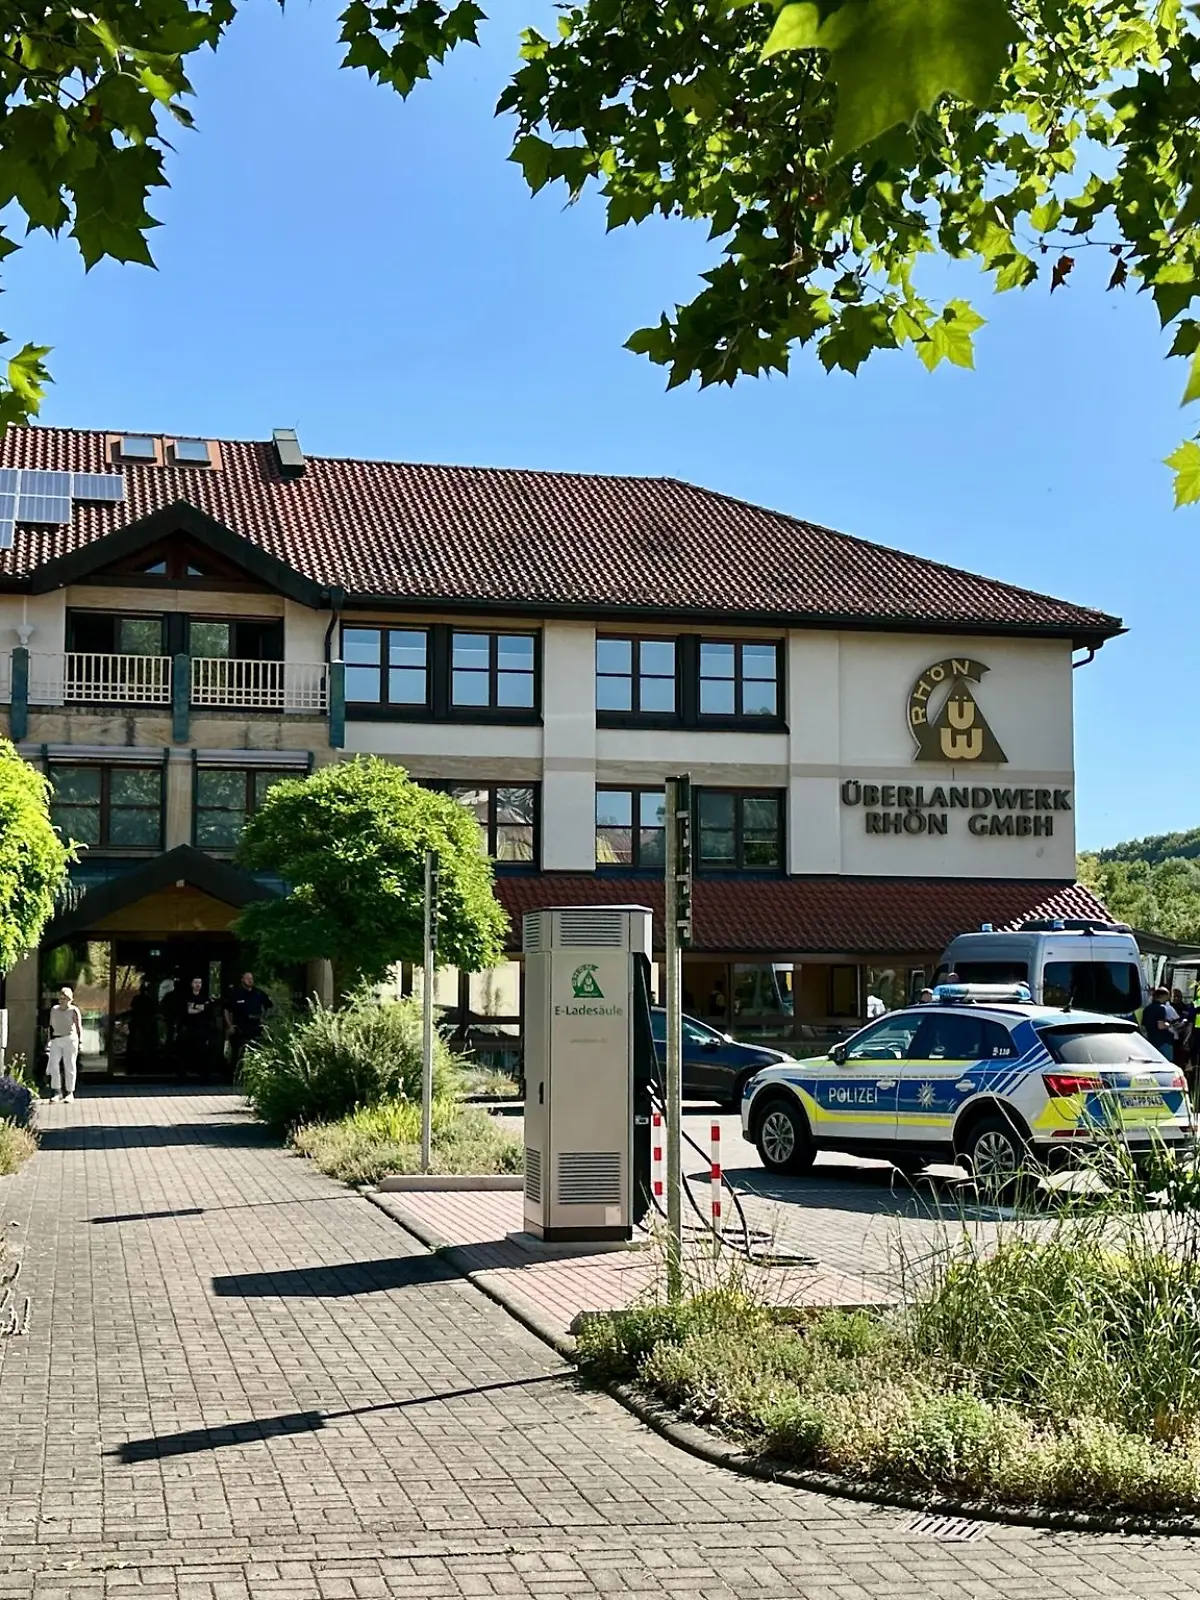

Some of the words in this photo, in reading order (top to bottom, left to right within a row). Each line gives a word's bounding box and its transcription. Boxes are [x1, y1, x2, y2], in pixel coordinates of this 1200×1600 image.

[911, 659, 969, 725] RHÖN
[841, 779, 1072, 810] ÜBERLANDWERK
[865, 808, 948, 835] RHÖN
[967, 813, 1054, 837] GMBH
[554, 1004, 624, 1016] E-Ladesäule
[828, 1087, 878, 1103] POLIZEI
